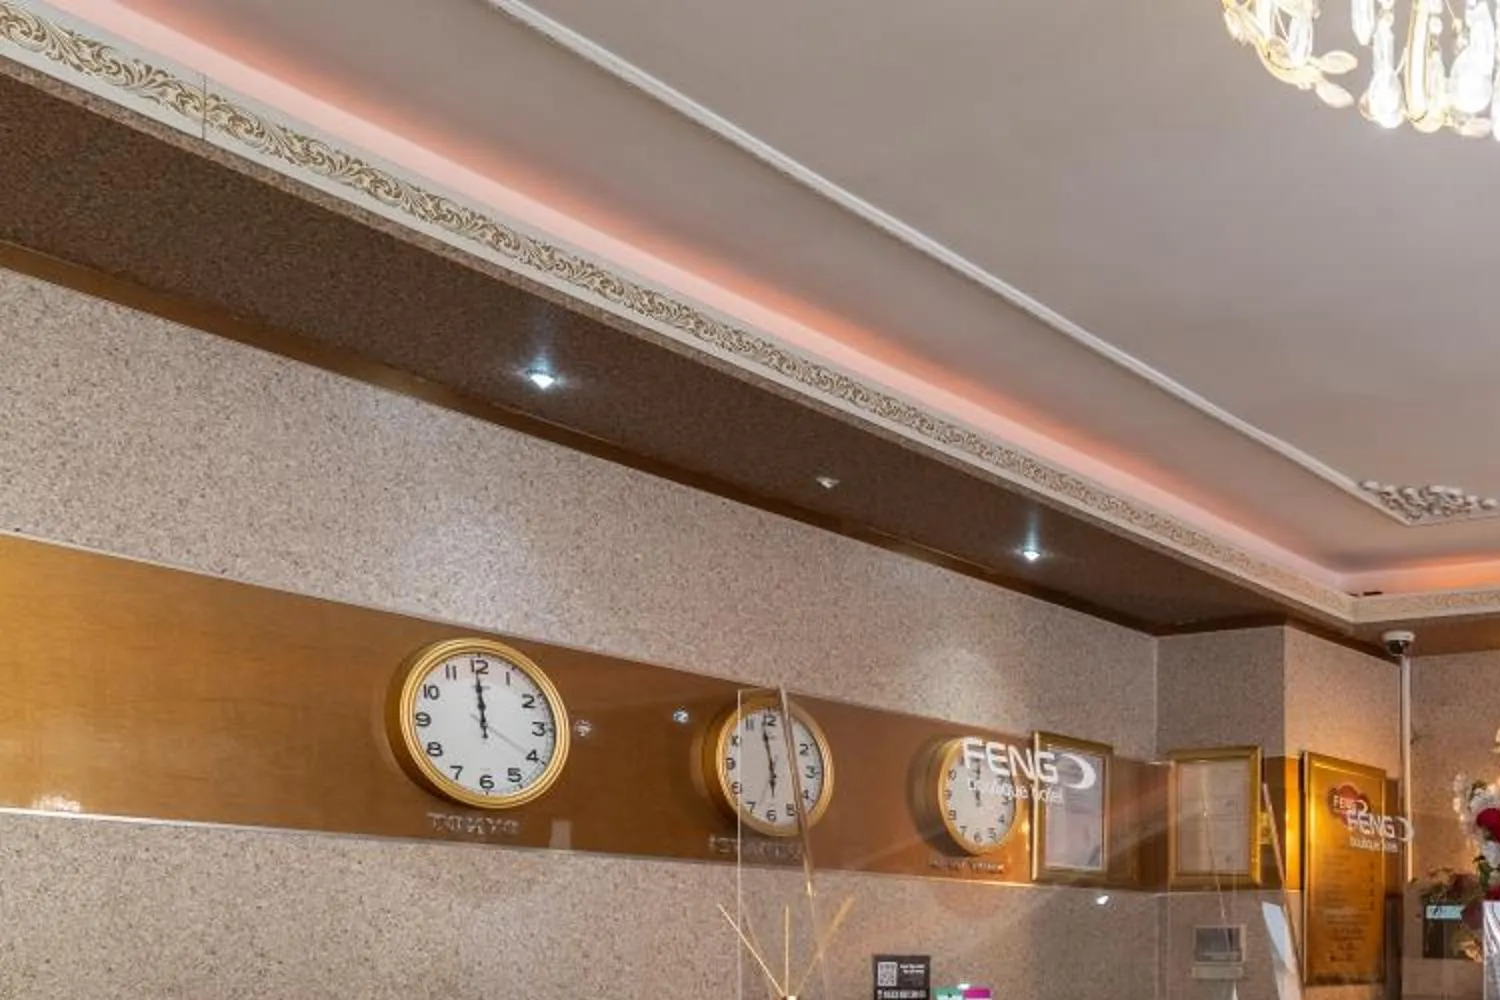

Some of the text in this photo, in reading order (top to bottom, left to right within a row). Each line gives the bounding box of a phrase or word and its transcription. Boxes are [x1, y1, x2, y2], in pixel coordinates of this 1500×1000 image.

[446, 665, 457, 680] 11
[470, 660, 489, 675] 12
[505, 672, 511, 685] 1
[423, 684, 440, 700] 10
[521, 694, 536, 709] 2
[415, 712, 432, 727] 9
[532, 721, 545, 737] 3
[426, 742, 444, 757] 8
[526, 749, 539, 763] 4
[962, 735, 1058, 784] FENG
[450, 766, 464, 780] 7
[507, 768, 522, 783] 5
[479, 775, 495, 789] 6
